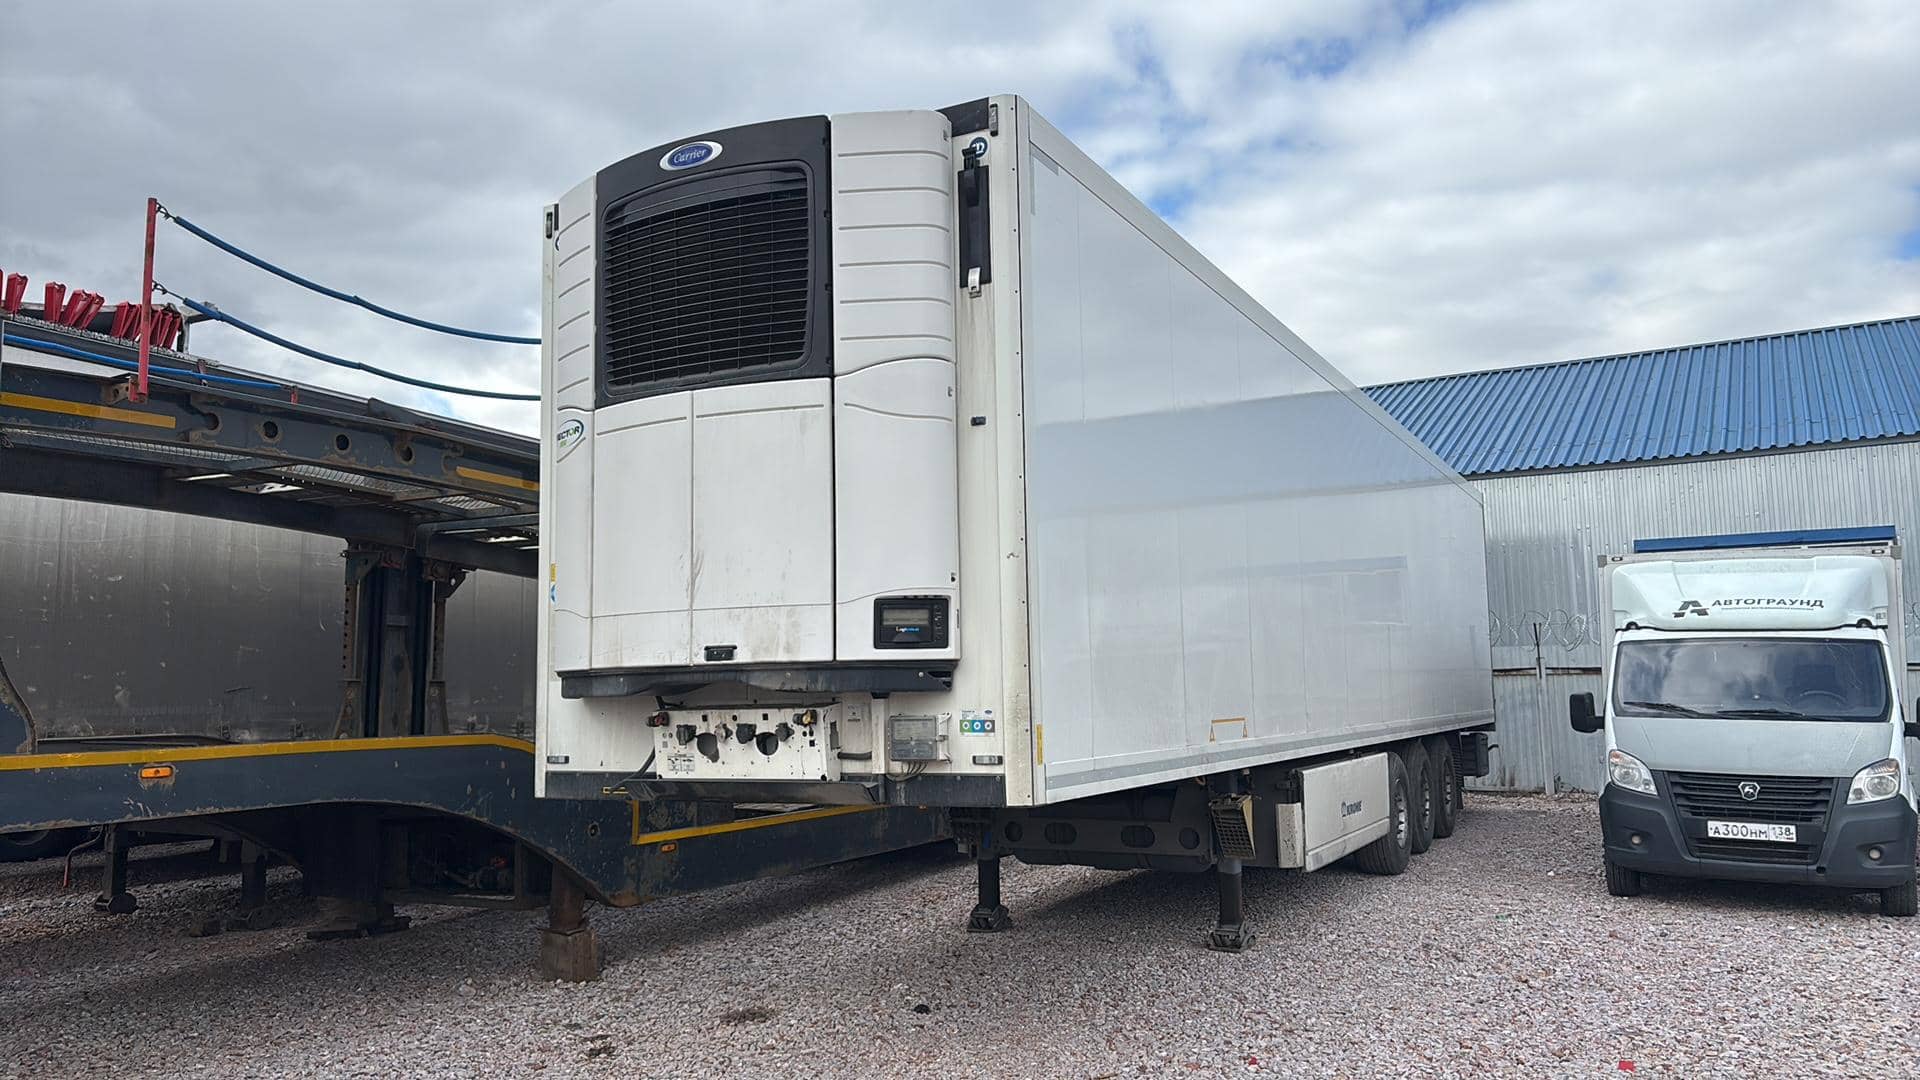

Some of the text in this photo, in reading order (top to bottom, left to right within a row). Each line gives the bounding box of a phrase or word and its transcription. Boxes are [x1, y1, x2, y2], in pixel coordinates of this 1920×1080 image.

[673, 149, 707, 163] Carrier
[556, 425, 580, 441] ECTOR
[1711, 598, 1825, 609] АВТОГРАУНД
